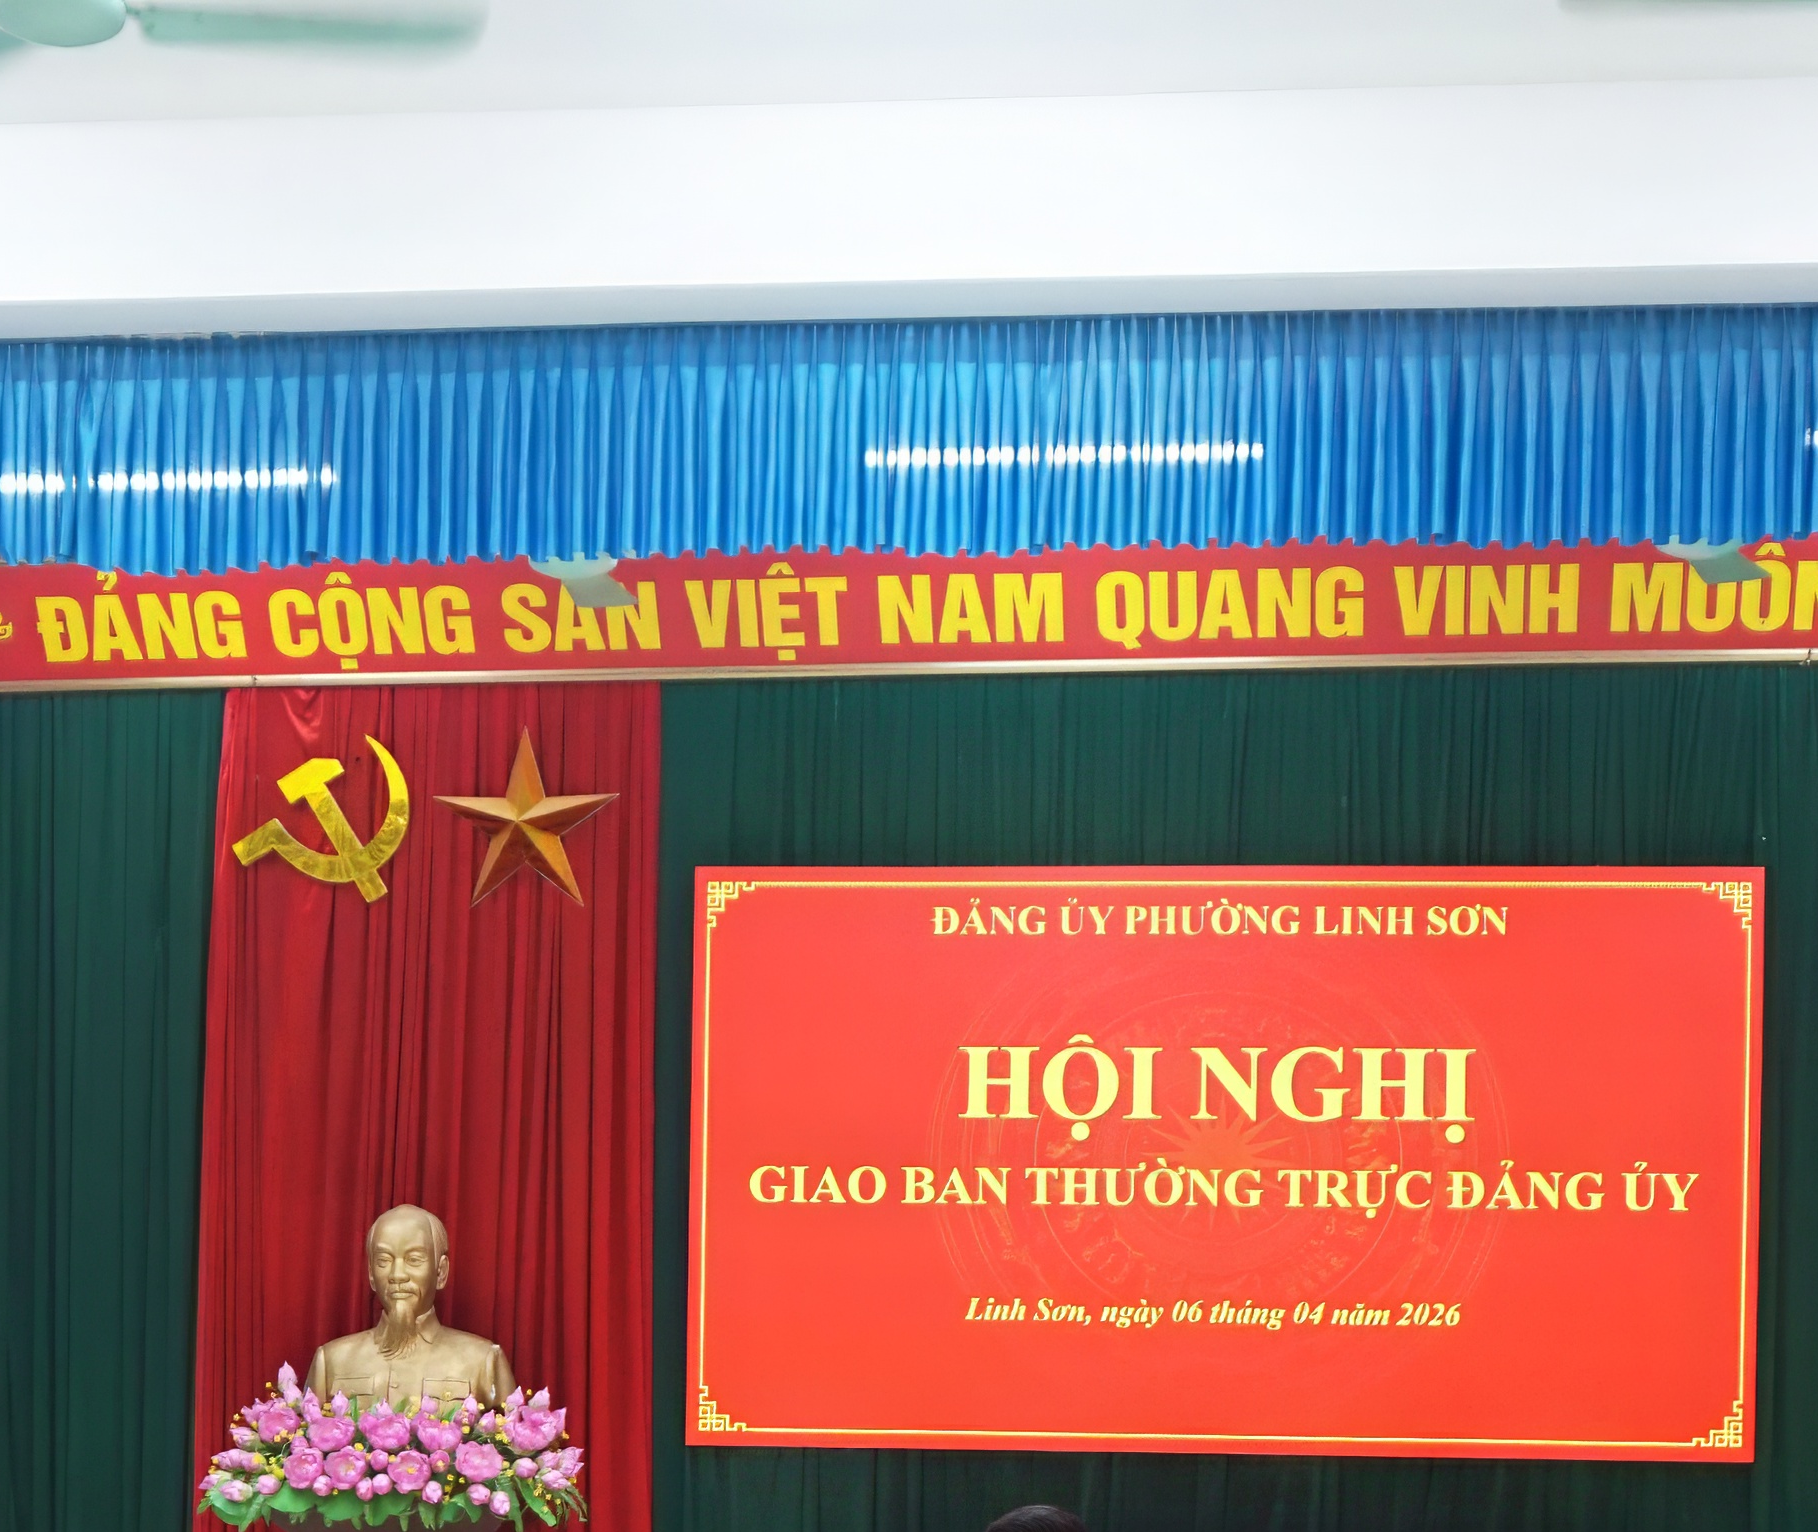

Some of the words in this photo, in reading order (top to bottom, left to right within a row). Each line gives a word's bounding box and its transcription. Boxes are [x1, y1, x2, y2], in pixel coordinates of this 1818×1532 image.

[35, 571, 248, 663] ĐẢNG
[268, 571, 477, 670] CỘNG
[684, 562, 848, 661] VIỆT
[878, 572, 1065, 645] NAM
[1095, 565, 1365, 650] QUANG
[1393, 562, 1581, 636] VINH
[931, 898, 1047, 936] ĐẢNG
[1060, 898, 1115, 936] ỦY
[1124, 898, 1301, 936] PHƯỜNG
[1313, 905, 1414, 937] LINH
[1424, 903, 1509, 937] SƠN
[957, 1033, 1163, 1141] HỘI
[1190, 1045, 1478, 1144] NGHỊ
[748, 1165, 888, 1205] GIAO
[900, 1166, 1012, 1205] BAN
[1024, 1157, 1264, 1208] THƯỜNG
[1276, 1163, 1433, 1219] TRỰC
[1445, 1159, 1605, 1212] ĐẢNG
[1621, 1160, 1701, 1213] ỦY
[964, 1297, 1027, 1322] Linh
[1032, 1297, 1092, 1326] Sơn,
[1100, 1298, 1164, 1329] ngày
[1171, 1299, 1204, 1324] 06
[1209, 1299, 1286, 1331] tháng
[1293, 1301, 1326, 1326] 04
[1330, 1303, 1391, 1327] năm
[1395, 1302, 1462, 1328] 2026
